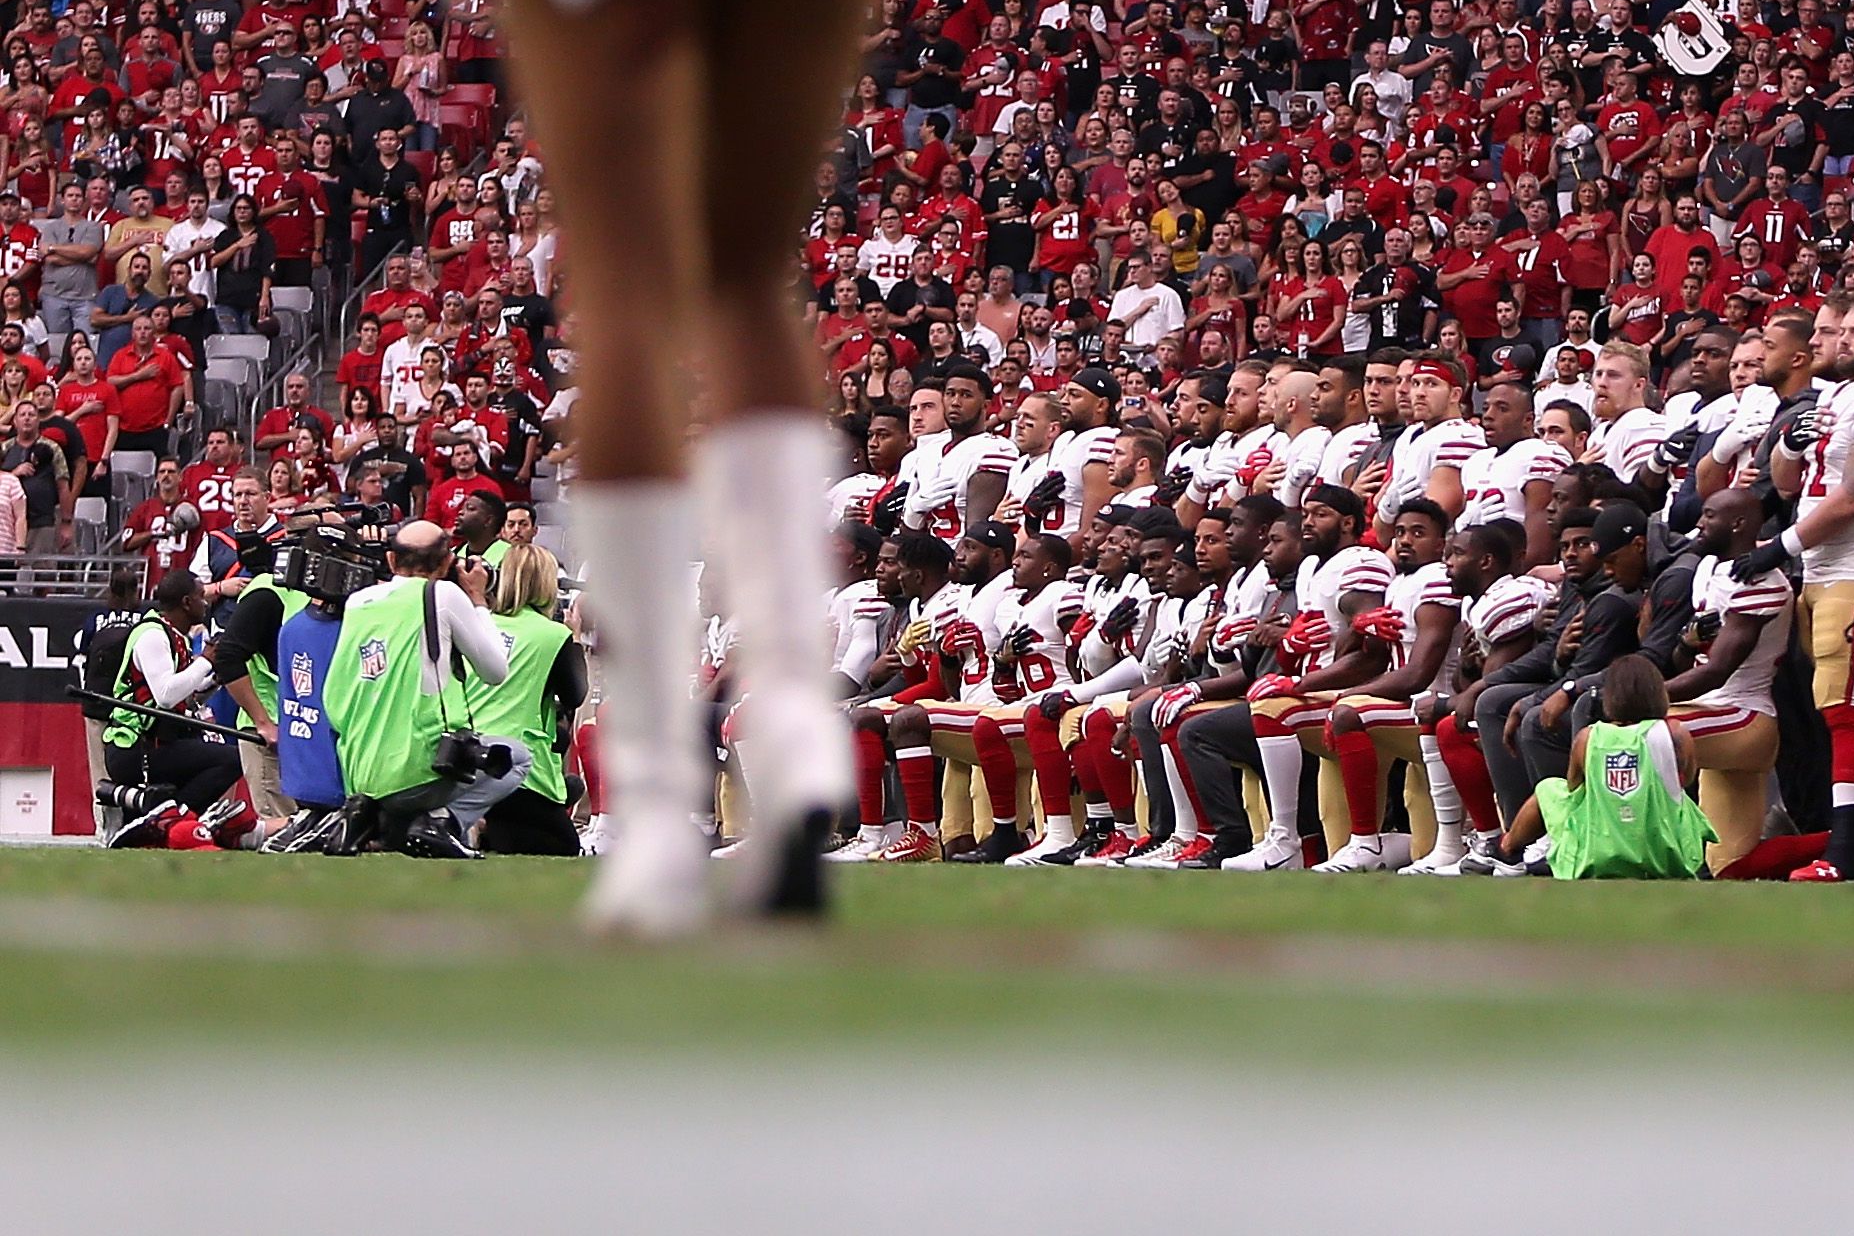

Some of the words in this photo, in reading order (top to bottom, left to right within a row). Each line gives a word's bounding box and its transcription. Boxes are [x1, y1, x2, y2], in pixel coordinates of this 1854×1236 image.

[194, 11, 227, 25] 49ERS
[228, 166, 266, 197] 52
[1052, 211, 1081, 241] 21
[1765, 214, 1784, 243] 11
[1608, 768, 1636, 787] NFL
